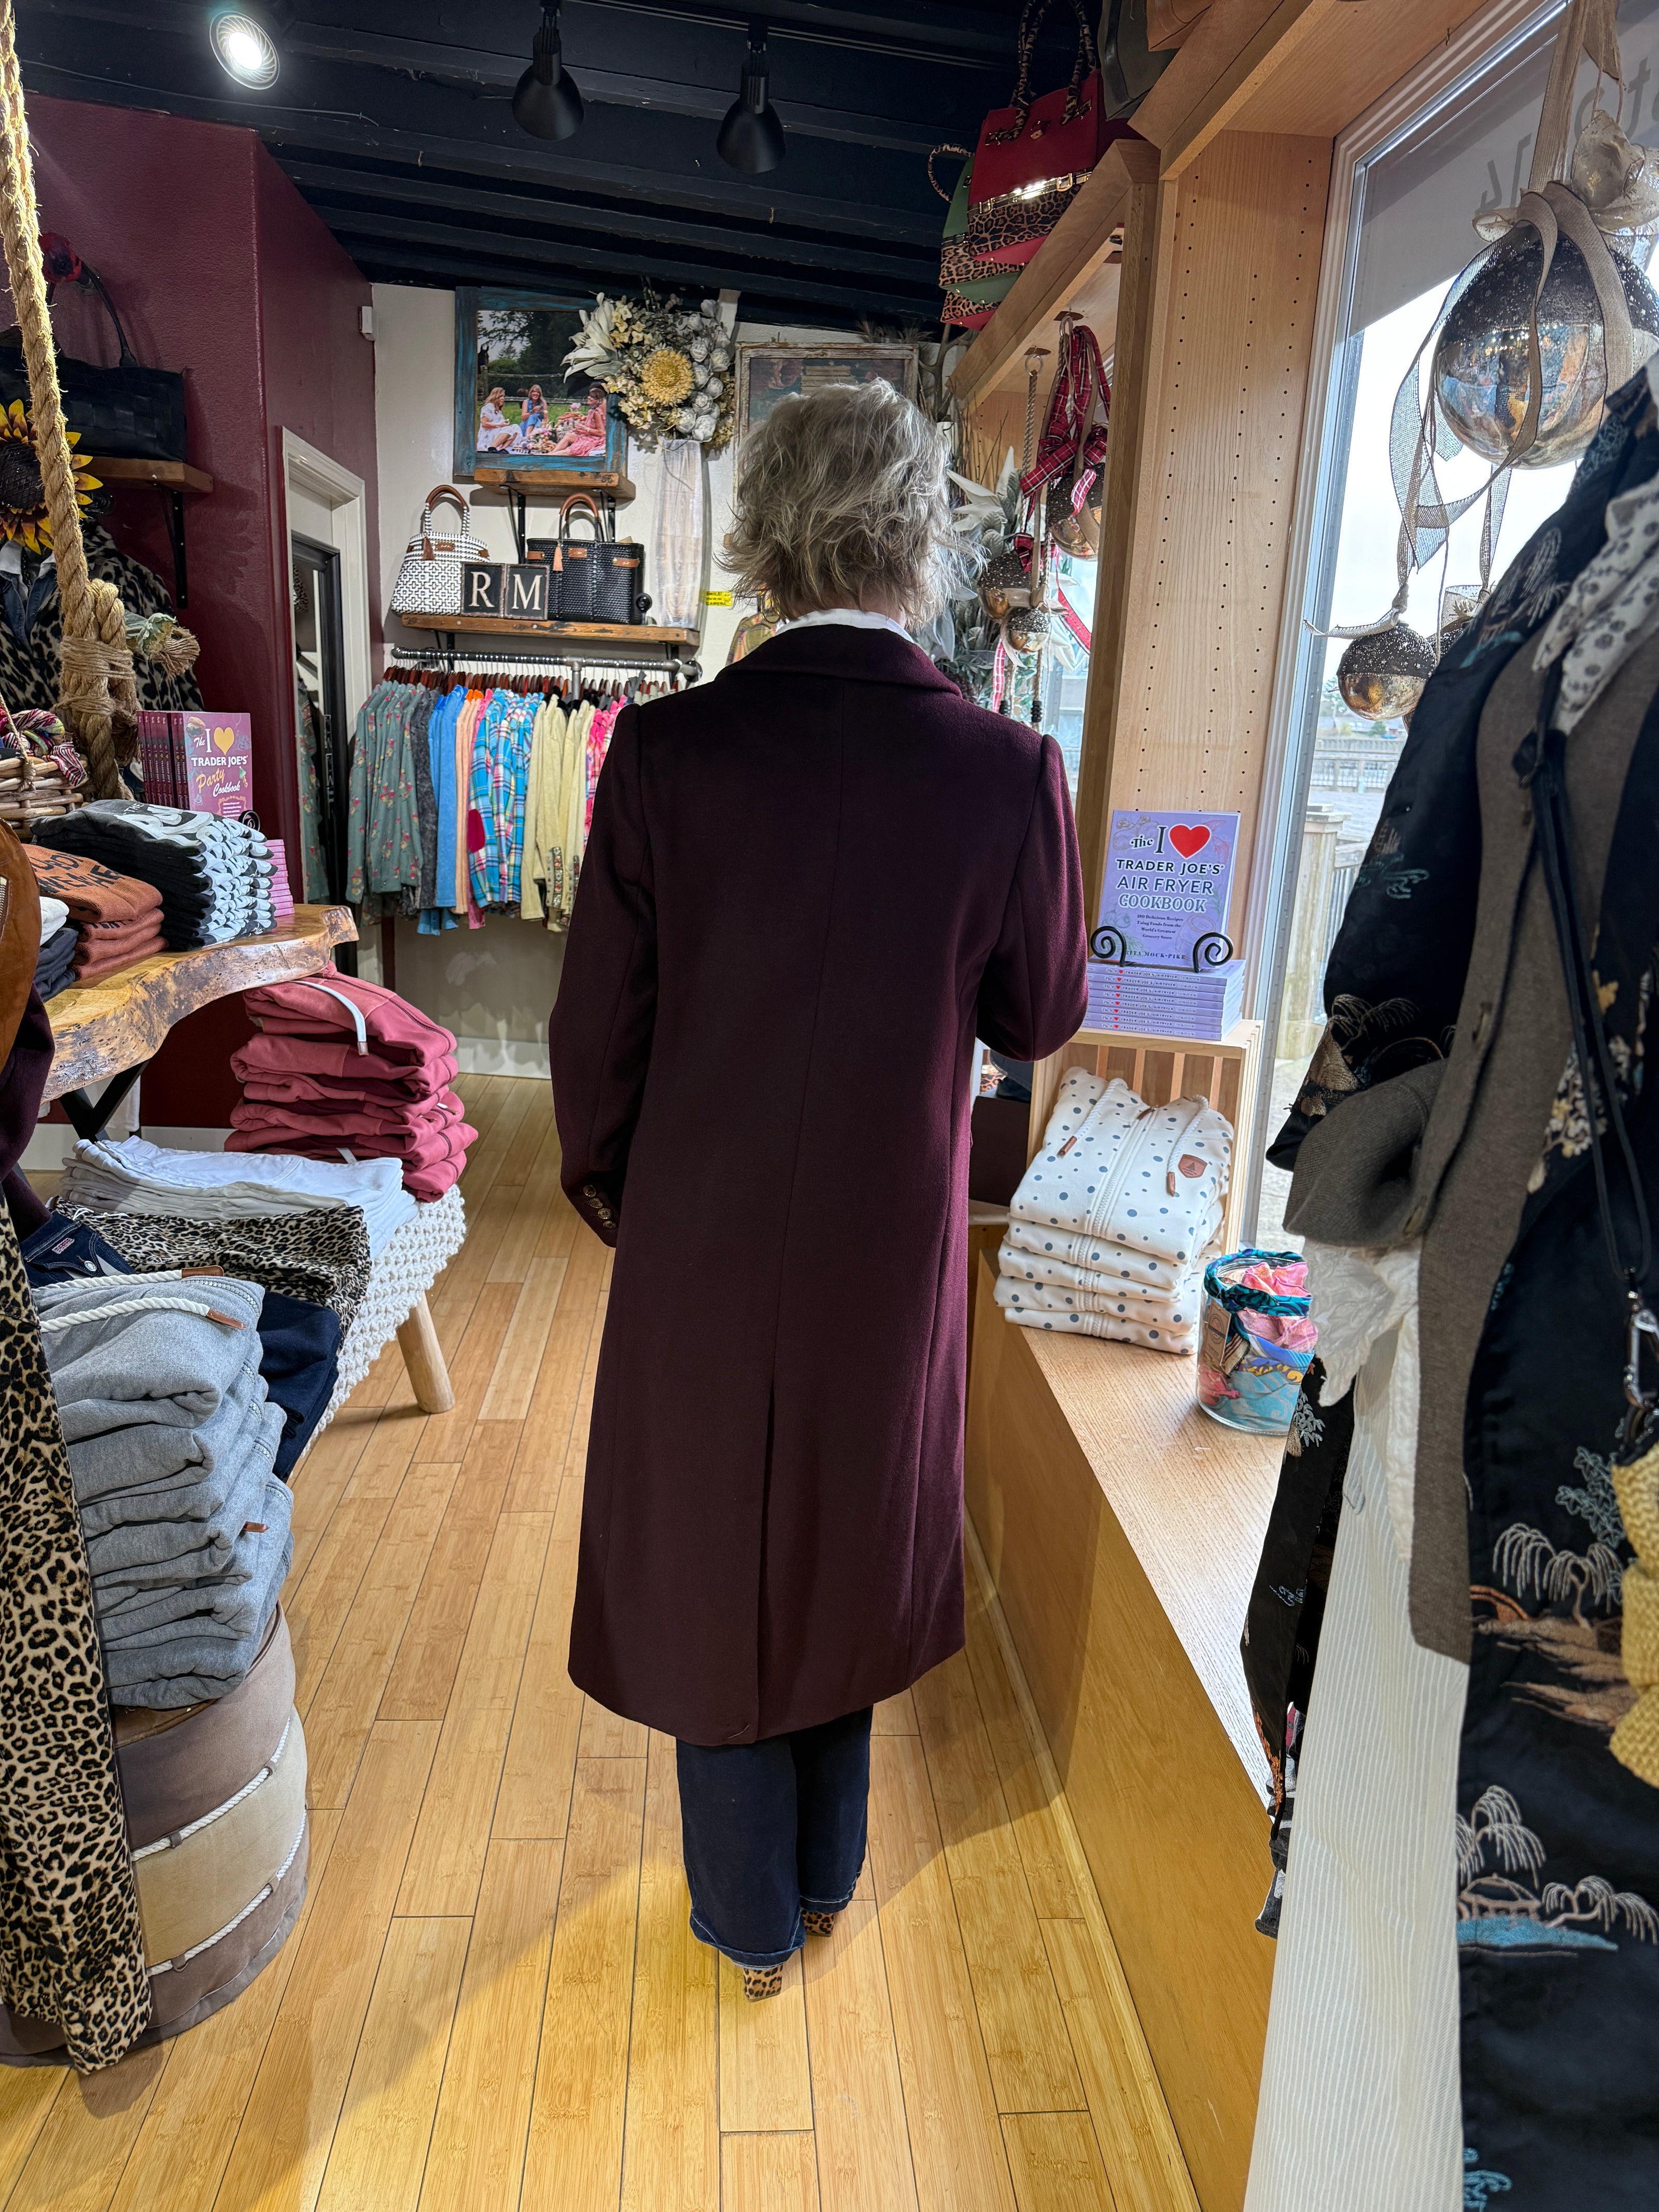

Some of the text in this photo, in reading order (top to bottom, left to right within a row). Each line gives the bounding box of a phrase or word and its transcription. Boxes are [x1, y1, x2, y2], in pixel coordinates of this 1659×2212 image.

[471, 571, 541, 611] R M
[194, 728, 211, 753] The I
[191, 756, 247, 767] TRADER JOE'S
[196, 768, 225, 794] Party
[213, 781, 240, 797] Cookbook
[1130, 826, 1166, 854] The I
[1117, 859, 1220, 876] TRADER JOE'S
[1116, 876, 1213, 895] AIR FRYER
[1119, 894, 1206, 912] COOKBOOK
